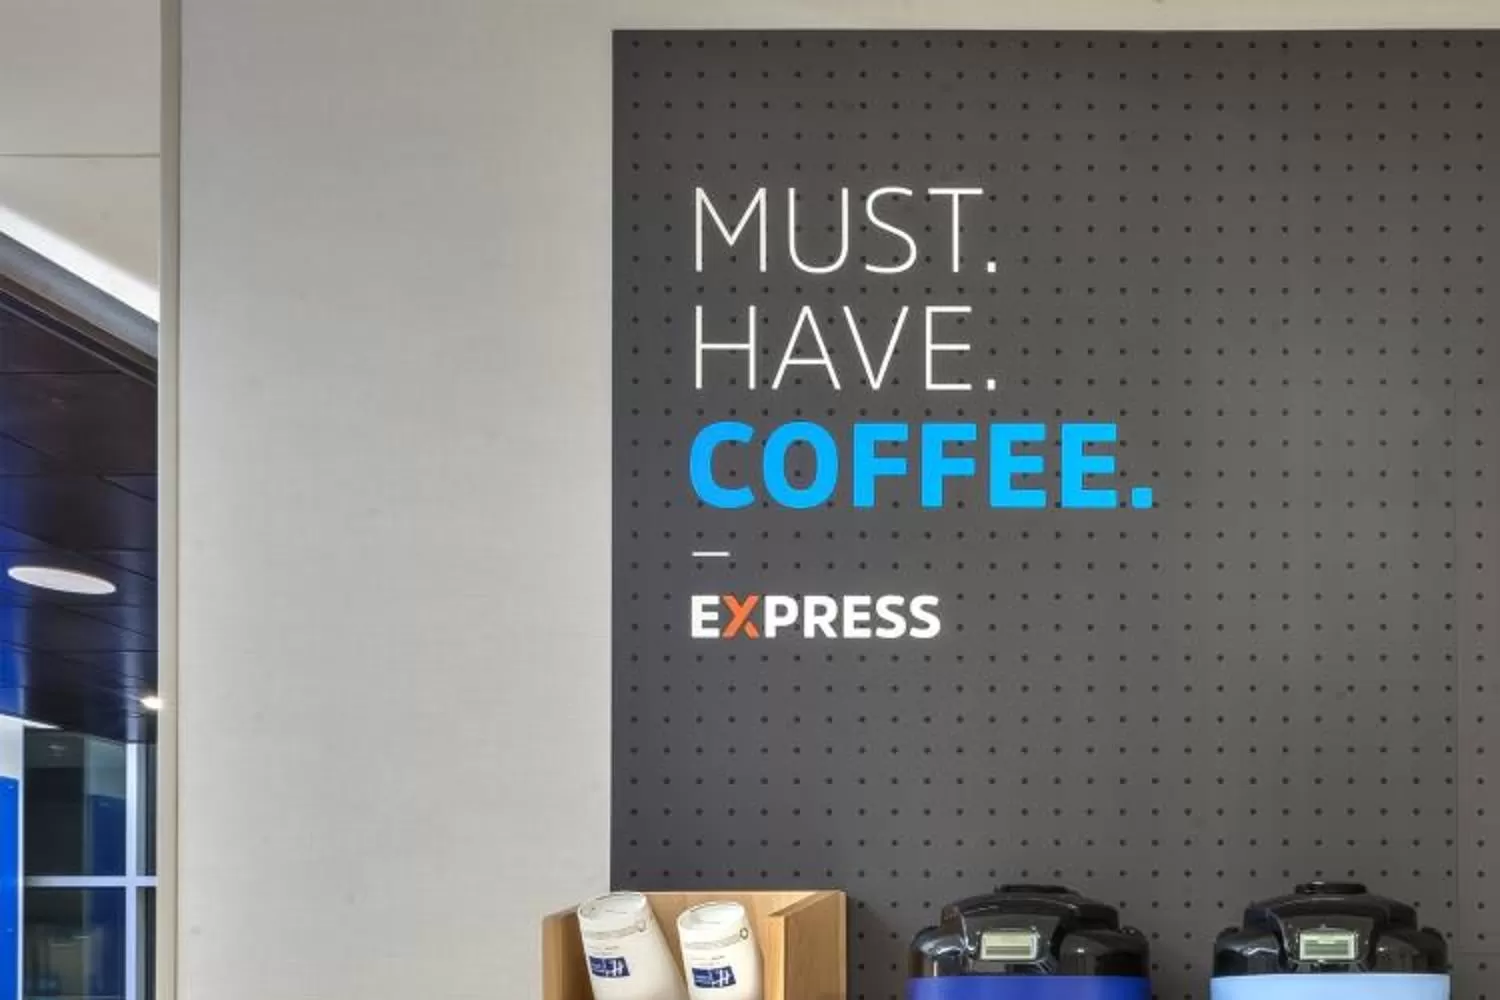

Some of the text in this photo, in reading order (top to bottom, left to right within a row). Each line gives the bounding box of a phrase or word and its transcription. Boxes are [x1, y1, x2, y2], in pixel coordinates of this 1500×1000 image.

[695, 186, 997, 274] MUST.
[695, 304, 996, 391] HAVE.
[688, 420, 1153, 510] COFFEE.
[690, 594, 942, 639] EXPRESS
